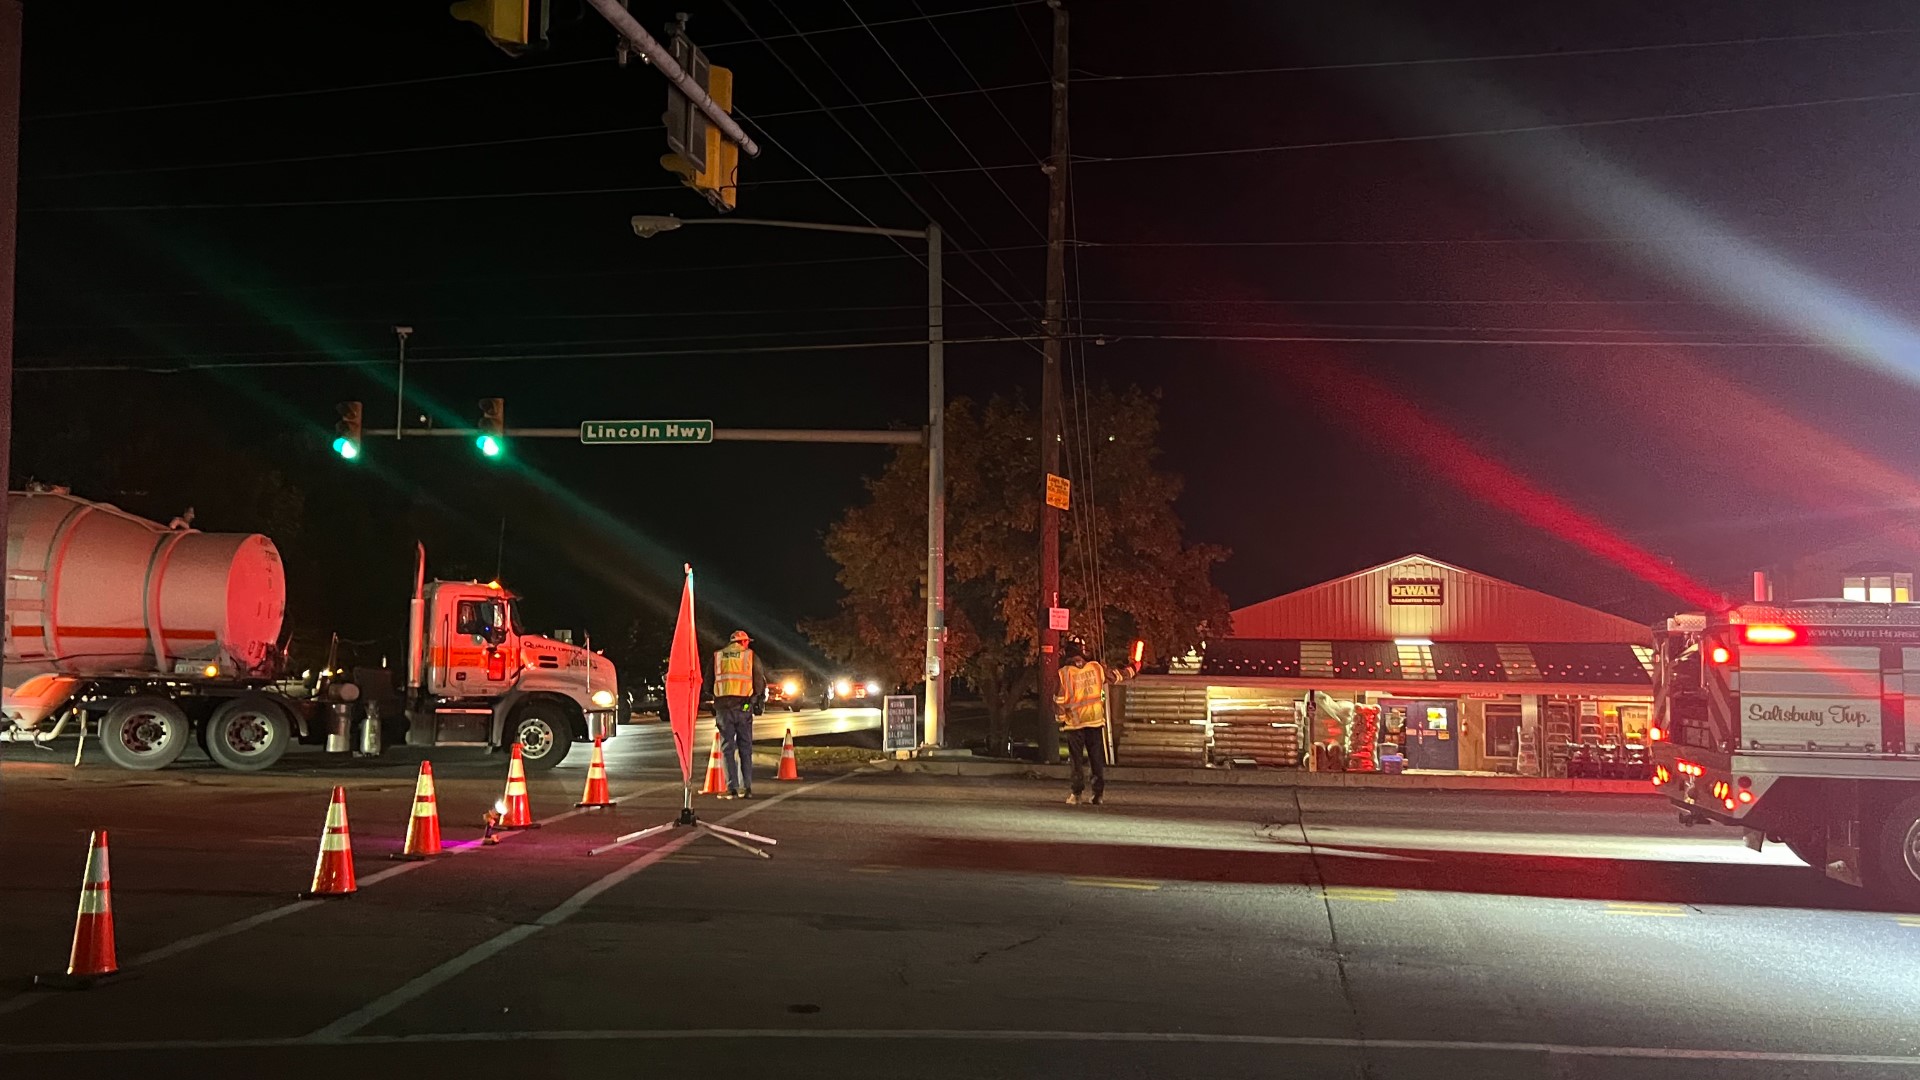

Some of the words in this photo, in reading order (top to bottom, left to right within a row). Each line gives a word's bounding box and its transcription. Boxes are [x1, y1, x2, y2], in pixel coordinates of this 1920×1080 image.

[587, 425, 660, 438] Lincoln
[666, 424, 706, 440] Hwy
[1748, 703, 1824, 727] Salisbury
[1828, 705, 1871, 727] Twp.
